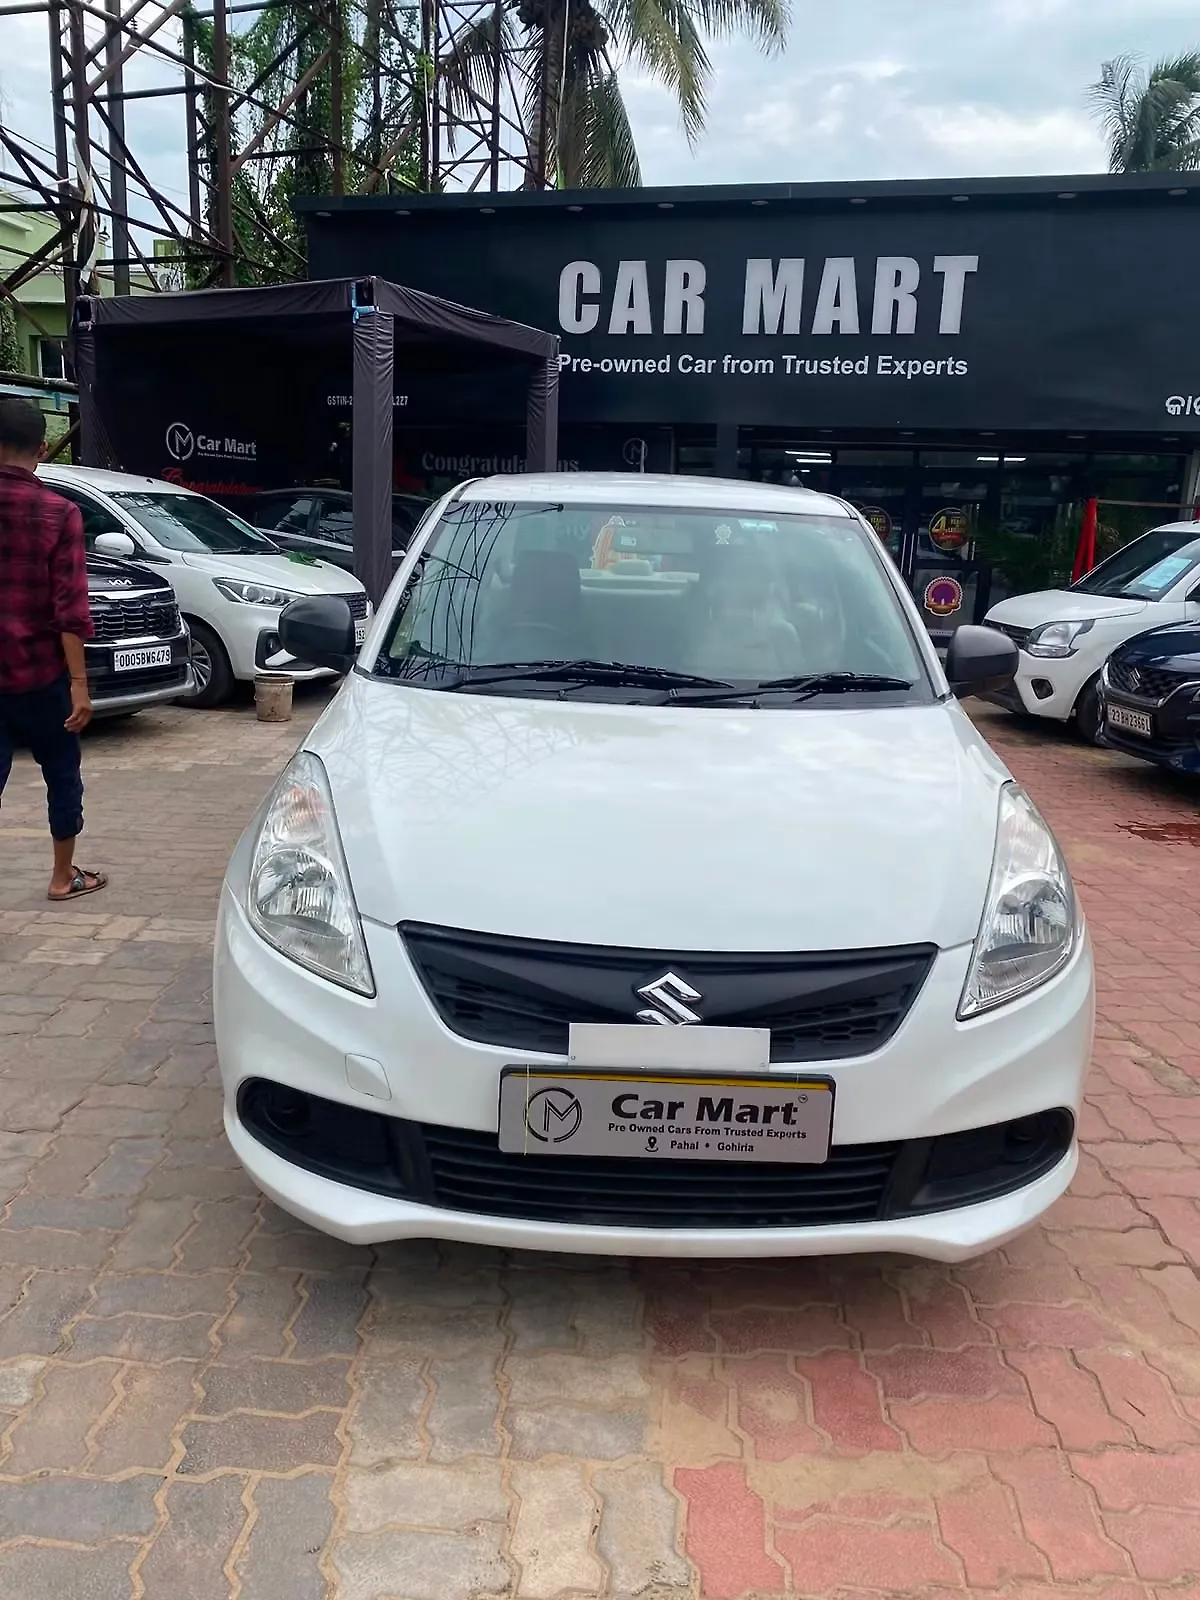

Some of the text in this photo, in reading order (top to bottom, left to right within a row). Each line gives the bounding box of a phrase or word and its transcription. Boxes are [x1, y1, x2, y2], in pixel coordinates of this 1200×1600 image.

[558, 255, 979, 335] CAR MART
[558, 354, 968, 379] Pre-owned Car from Trusted Experts
[196, 435, 257, 455] Car Mart
[611, 1093, 799, 1126] Car Mart
[608, 1122, 807, 1140] Pre Owned Cars From Trusted Experts
[670, 1140, 754, 1152] Pahal Gohiria
